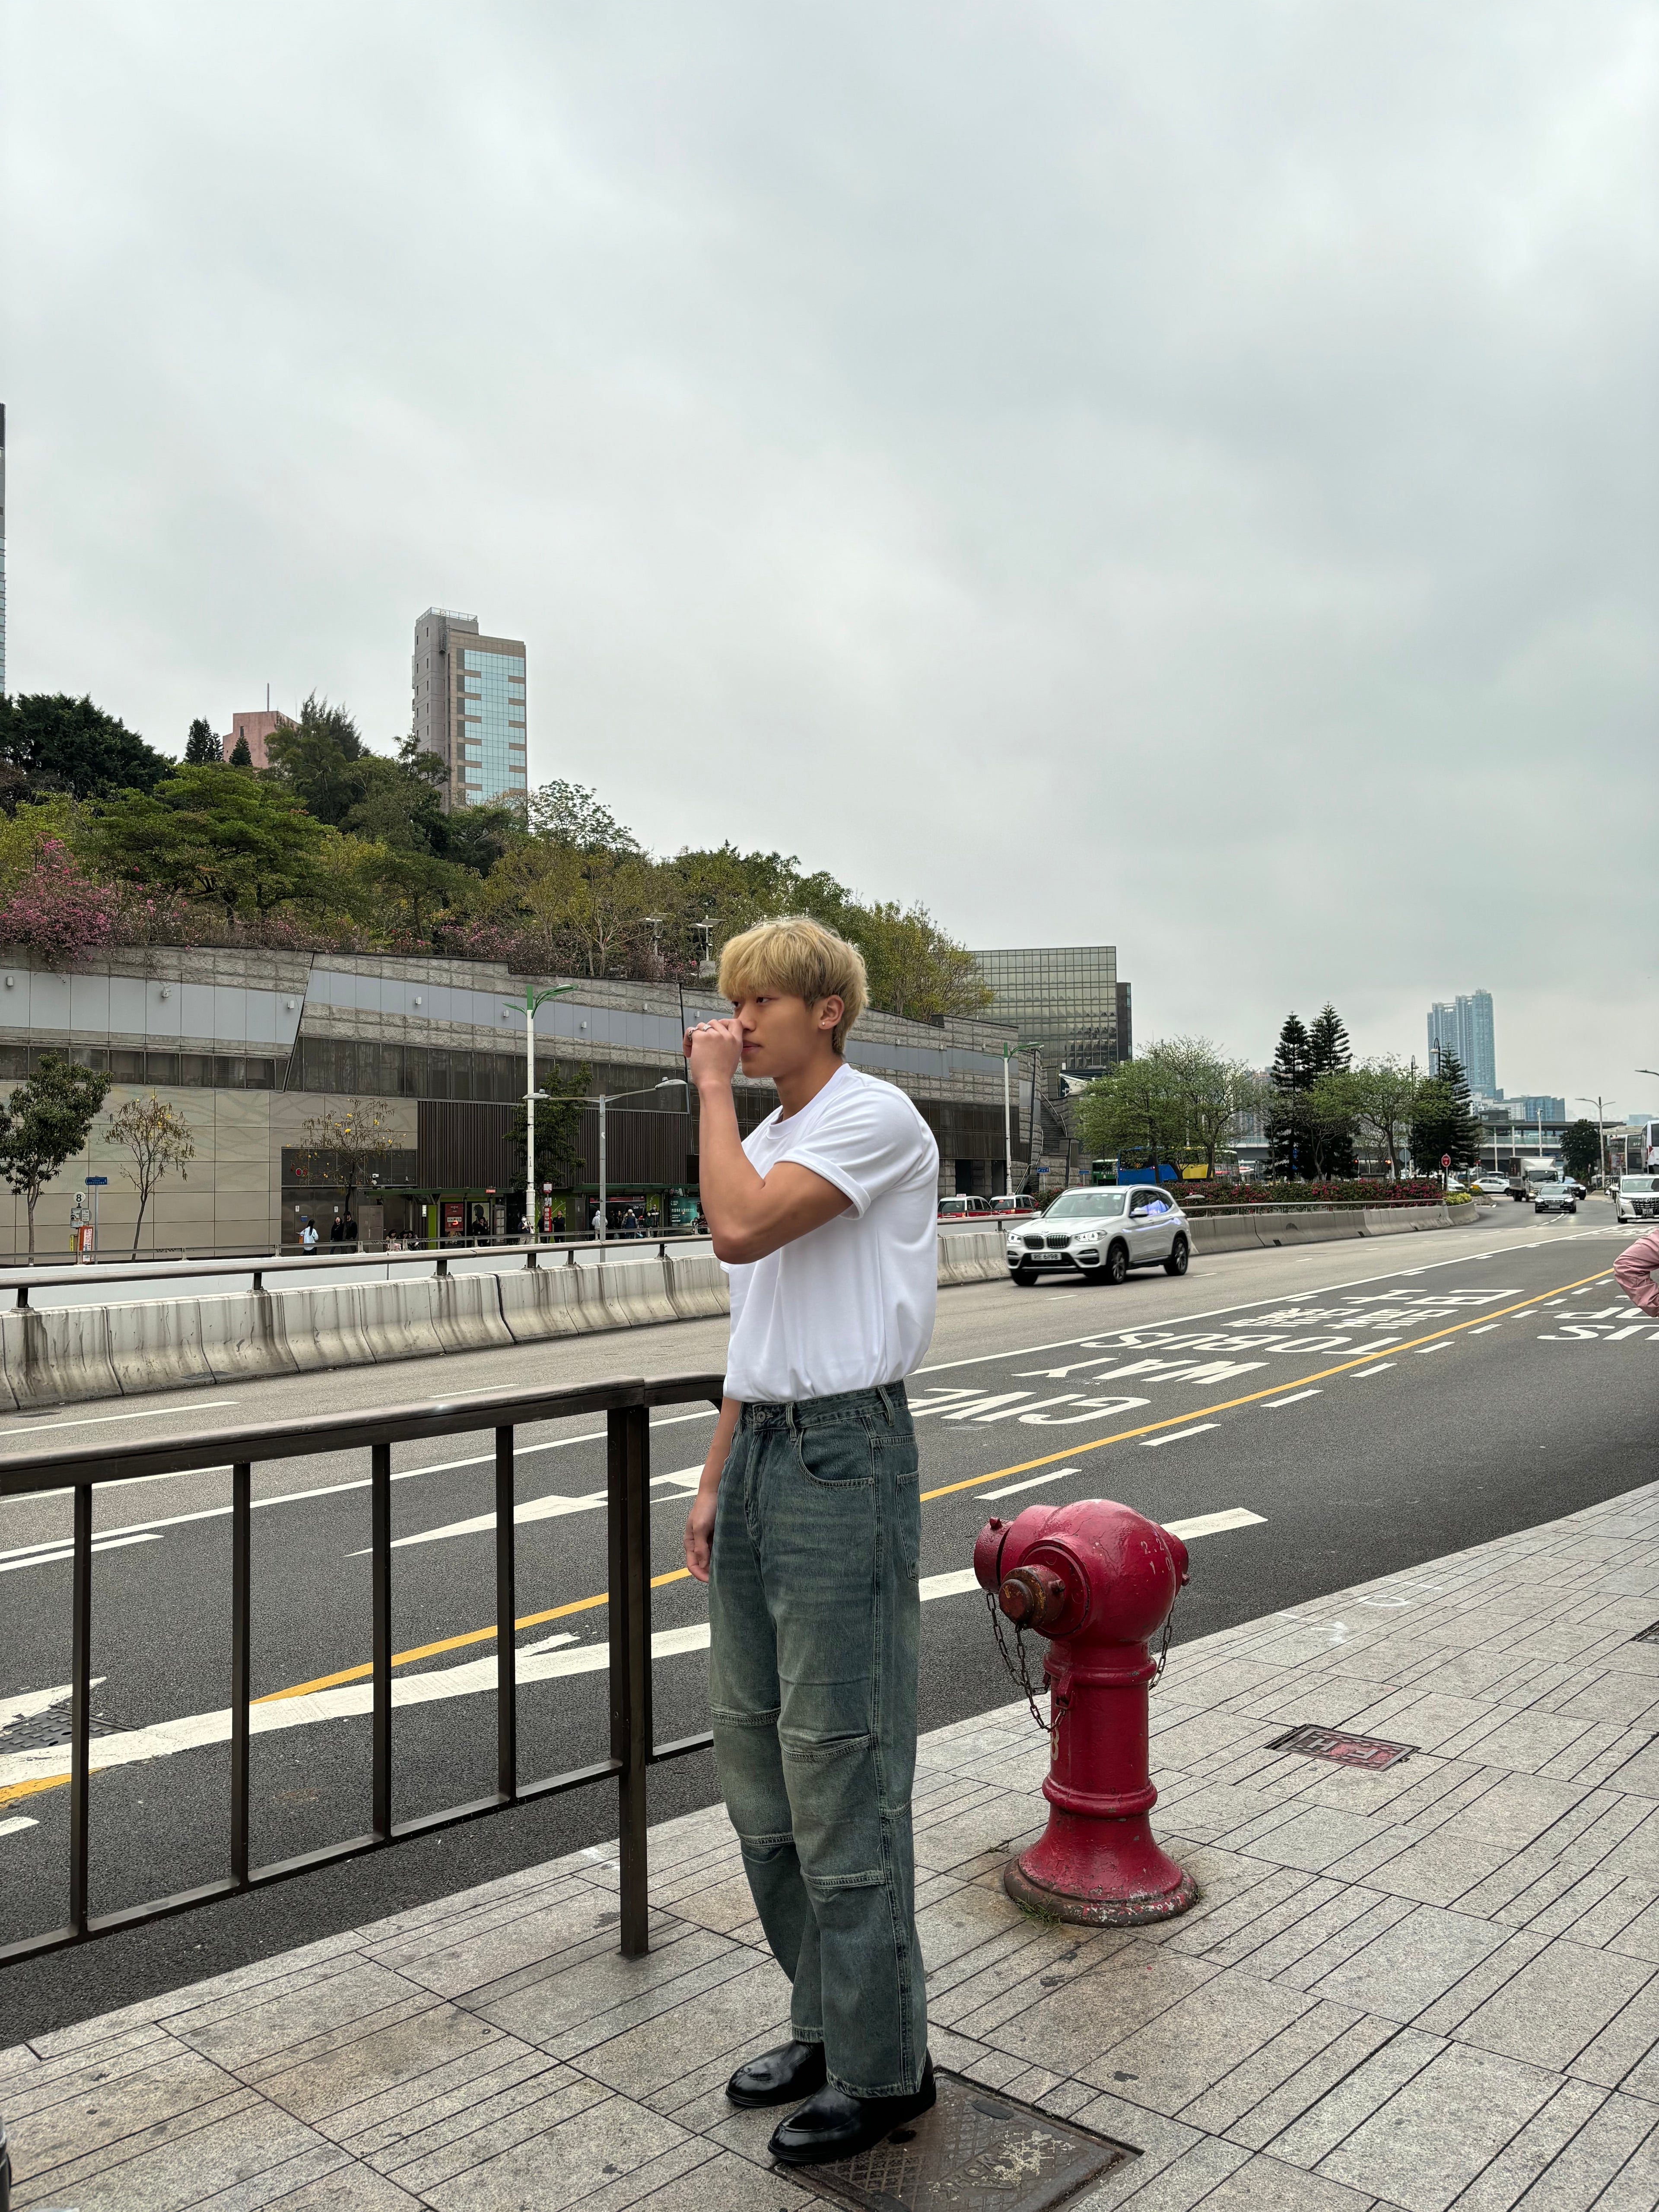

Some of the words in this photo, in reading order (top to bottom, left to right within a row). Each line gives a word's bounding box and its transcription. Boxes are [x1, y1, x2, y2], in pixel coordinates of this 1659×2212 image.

[76, 1194, 82, 1202] 8
[1340, 1289, 1525, 1305] 巴士
[1080, 1332, 1293, 1351] BUS
[1536, 1325, 1659, 1340] US
[1263, 1336, 1404, 1355] TO
[1011, 1357, 1271, 1384] WAY
[908, 1388, 1151, 1424] GIVE
